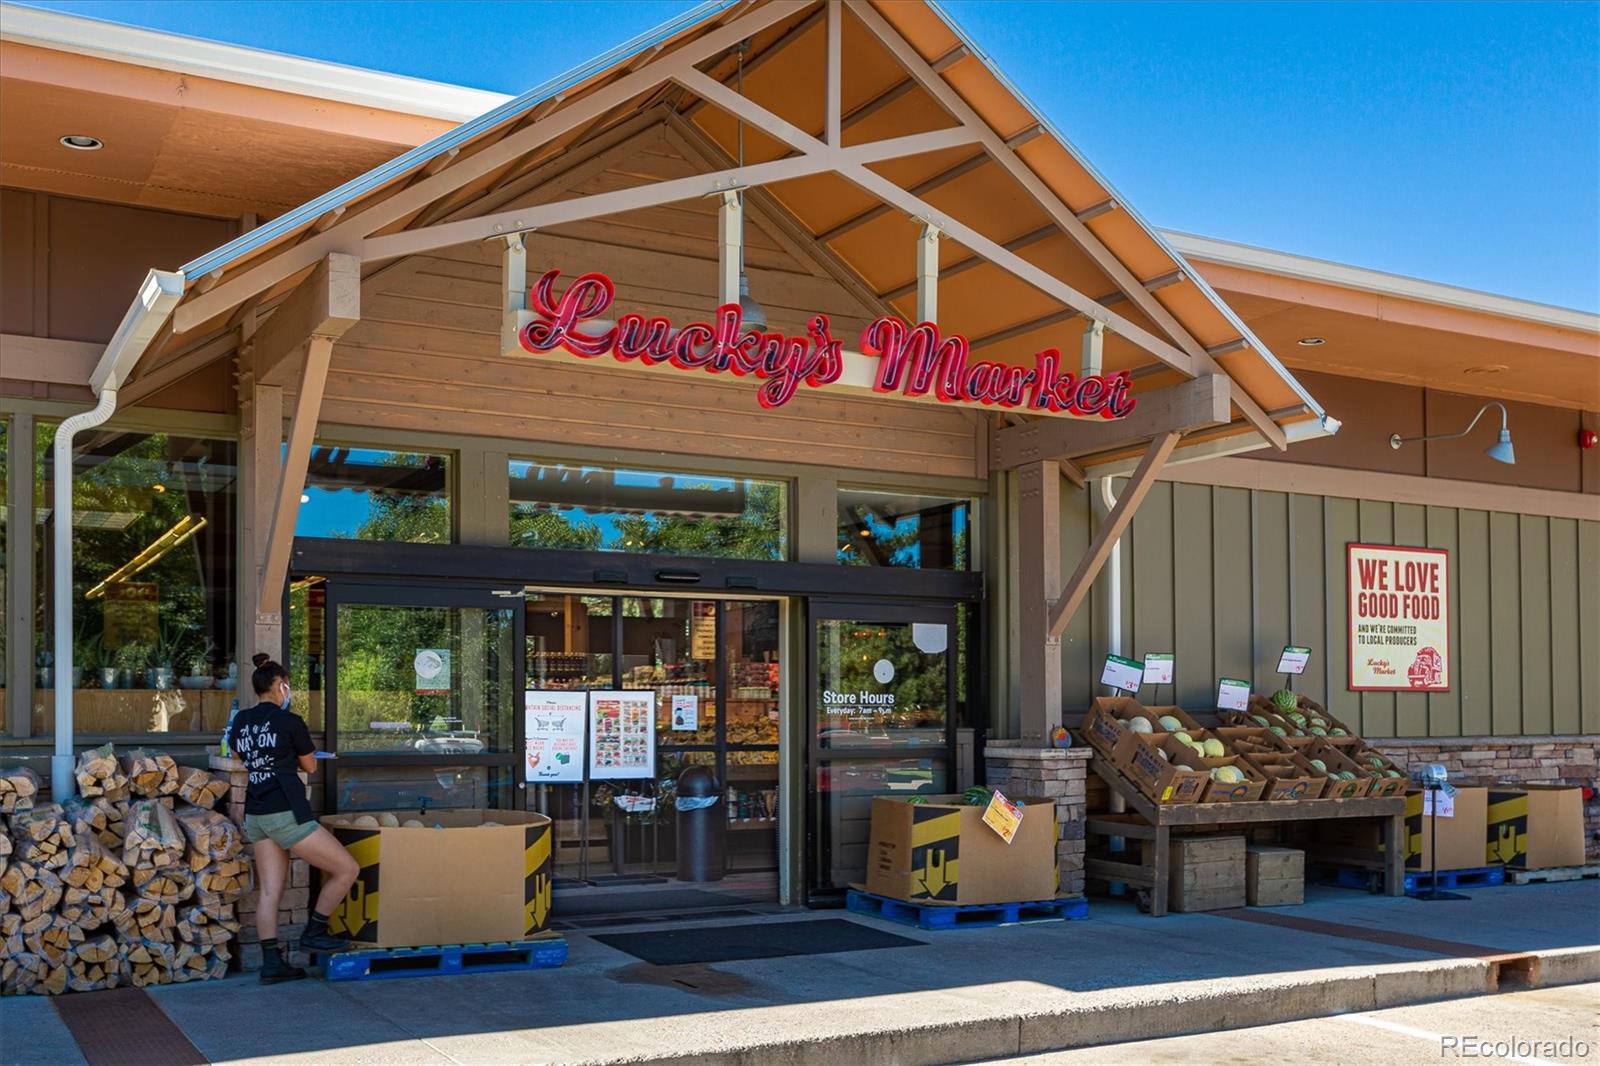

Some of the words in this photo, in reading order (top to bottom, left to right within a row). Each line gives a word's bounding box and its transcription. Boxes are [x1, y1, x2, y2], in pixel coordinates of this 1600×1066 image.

[519, 268, 844, 409] Lucky's
[860, 315, 1138, 419] Market
[1357, 558, 1388, 590] WE
[1394, 560, 1439, 593] LOVE
[1358, 592, 1398, 618] GOOD
[1403, 594, 1440, 620] FOOD
[1358, 624, 1369, 633] AND
[1370, 624, 1386, 634] WE'RE
[1387, 625, 1417, 634] COMMITTED
[1358, 635, 1366, 645] TO
[1366, 635, 1384, 645] LOCAL
[1385, 636, 1417, 646] PRODUCERS
[1367, 658, 1390, 668] Lucky's
[1373, 667, 1396, 675] Market
[823, 690, 857, 704] Store
[860, 690, 895, 704] Hours
[826, 706, 856, 716] Everyday:
[858, 706, 873, 714] 7am
